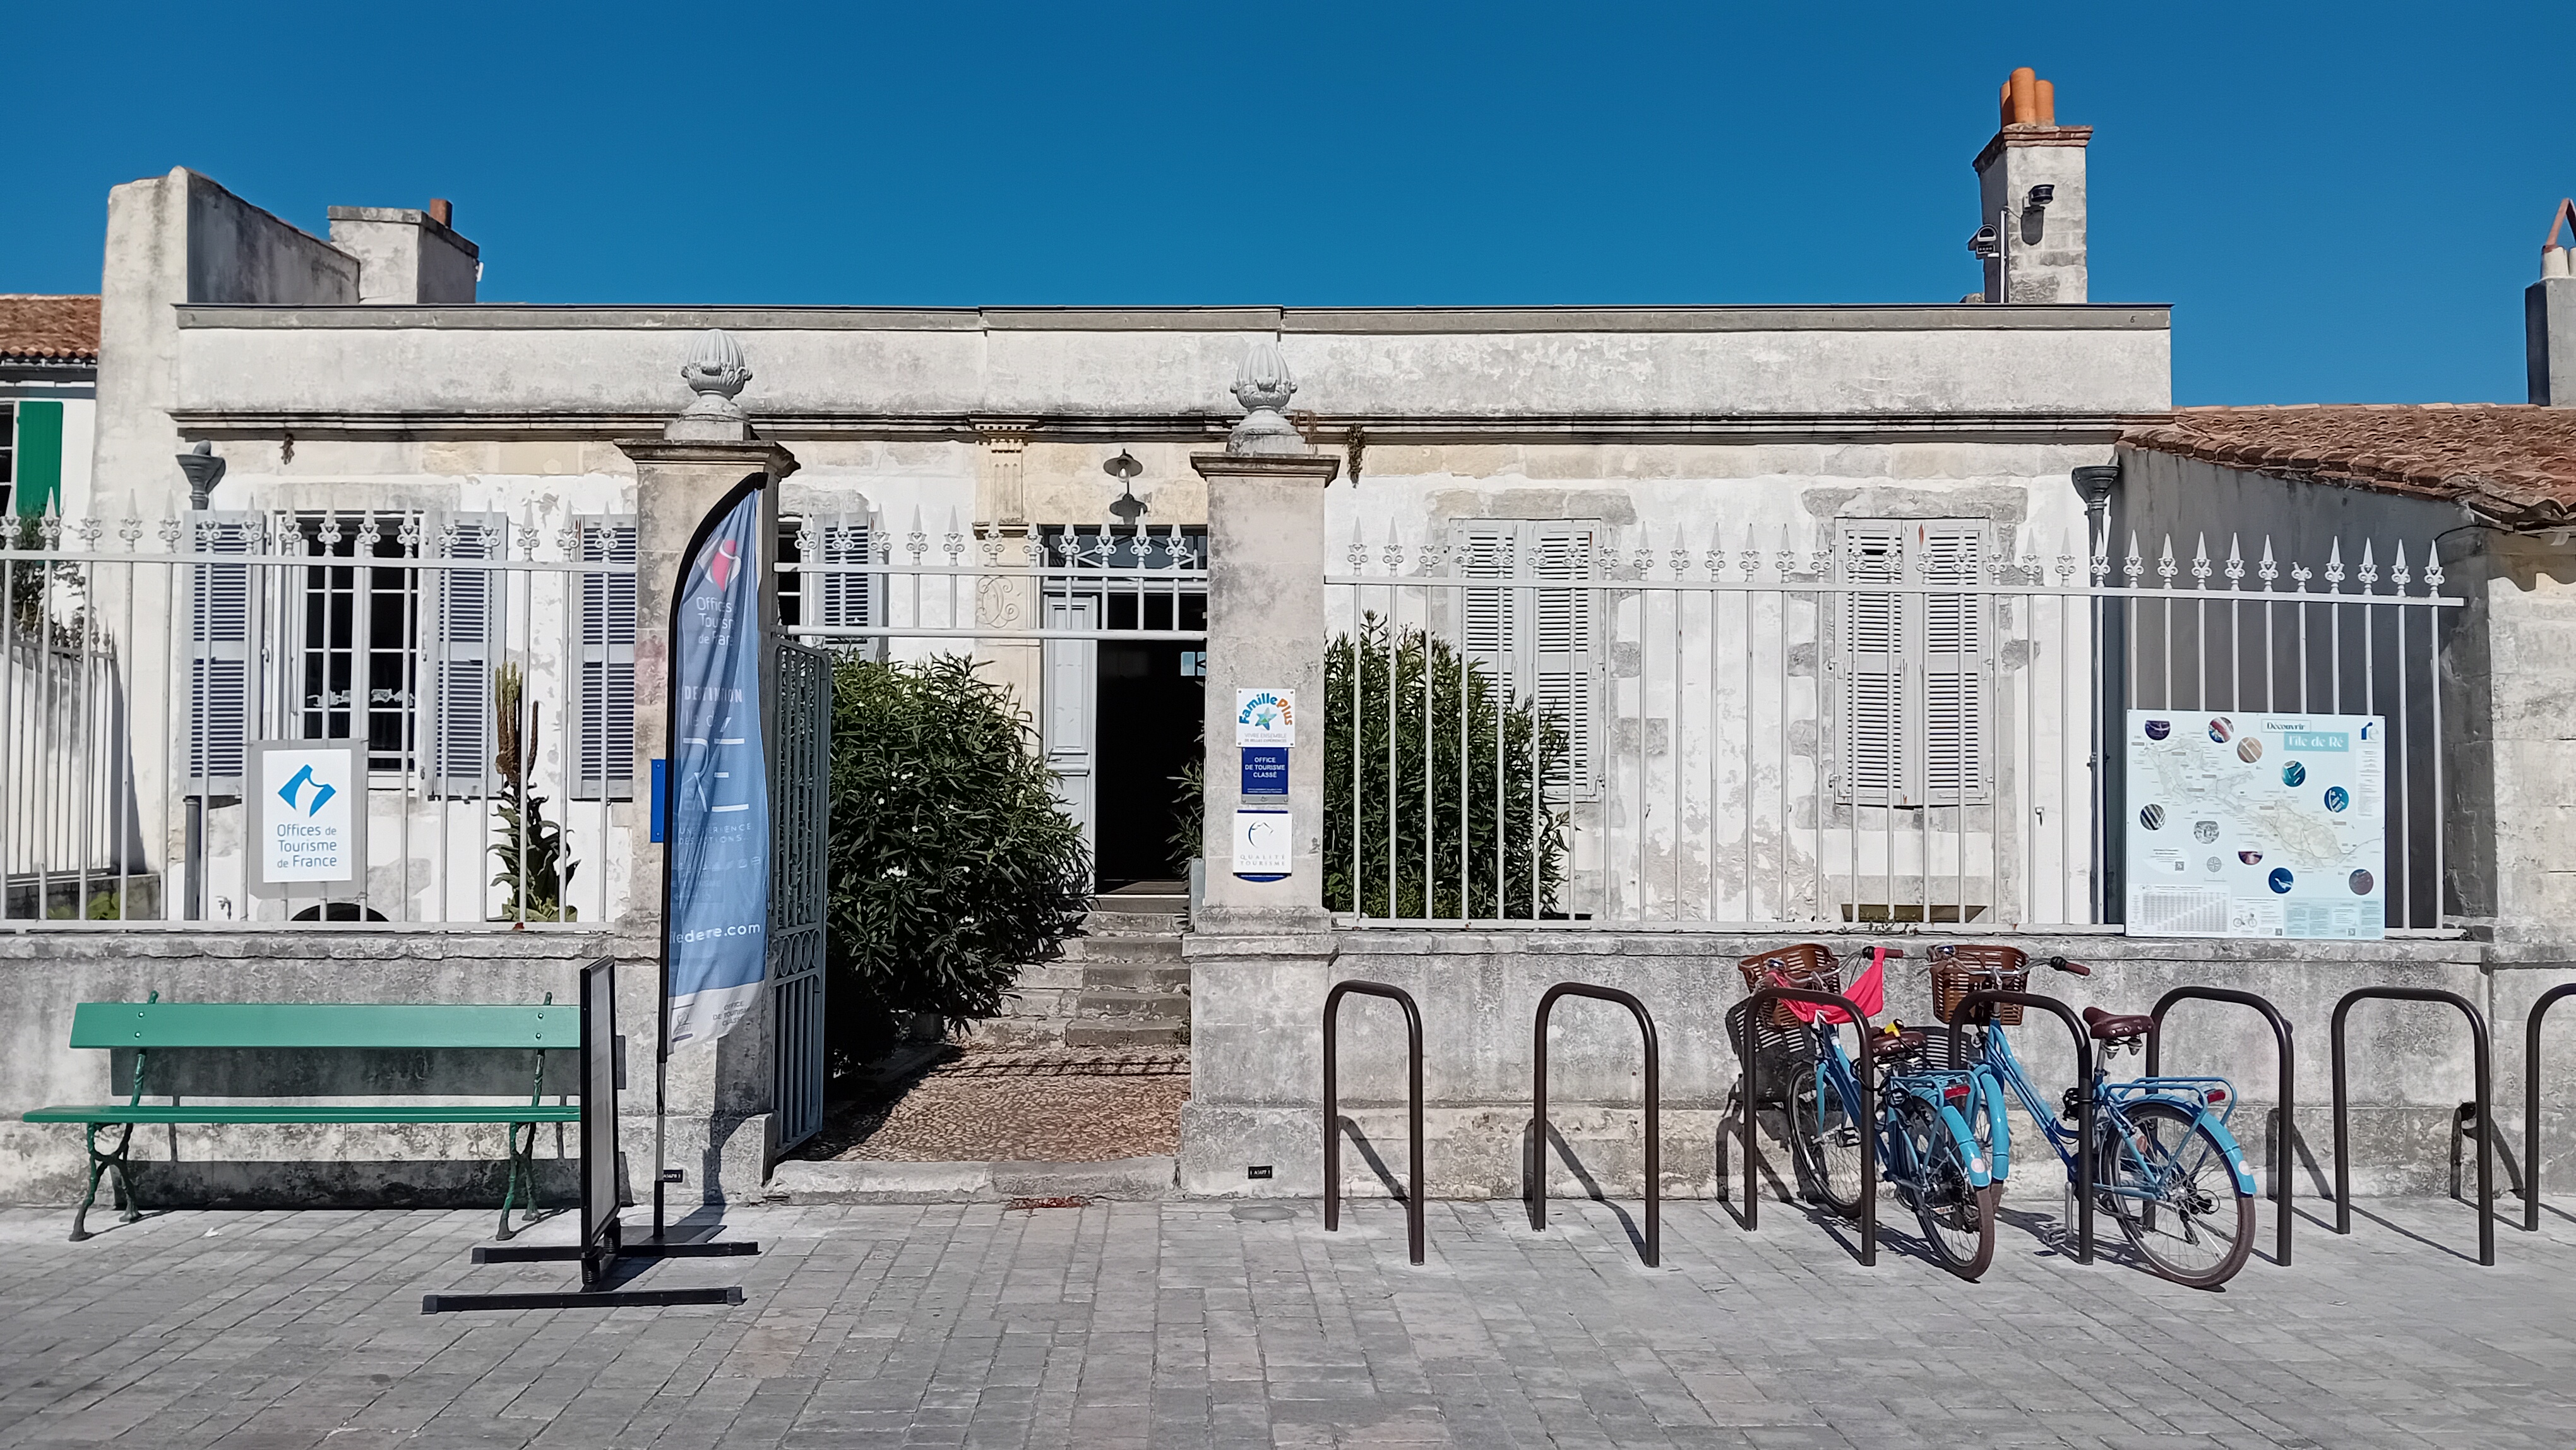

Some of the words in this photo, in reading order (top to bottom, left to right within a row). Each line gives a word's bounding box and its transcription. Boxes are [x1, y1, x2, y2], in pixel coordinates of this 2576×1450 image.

[698, 634, 710, 644] de
[1239, 693, 1278, 724] Famille
[1276, 698, 1293, 726] Plus
[2267, 722, 2305, 731] Découvrir
[2311, 736, 2326, 747] de
[2329, 736, 2344, 748] Ré
[277, 824, 321, 837] Offices
[325, 826, 337, 836] de
[277, 839, 337, 853] Tourisme
[277, 859, 289, 868] de
[292, 854, 337, 868] France
